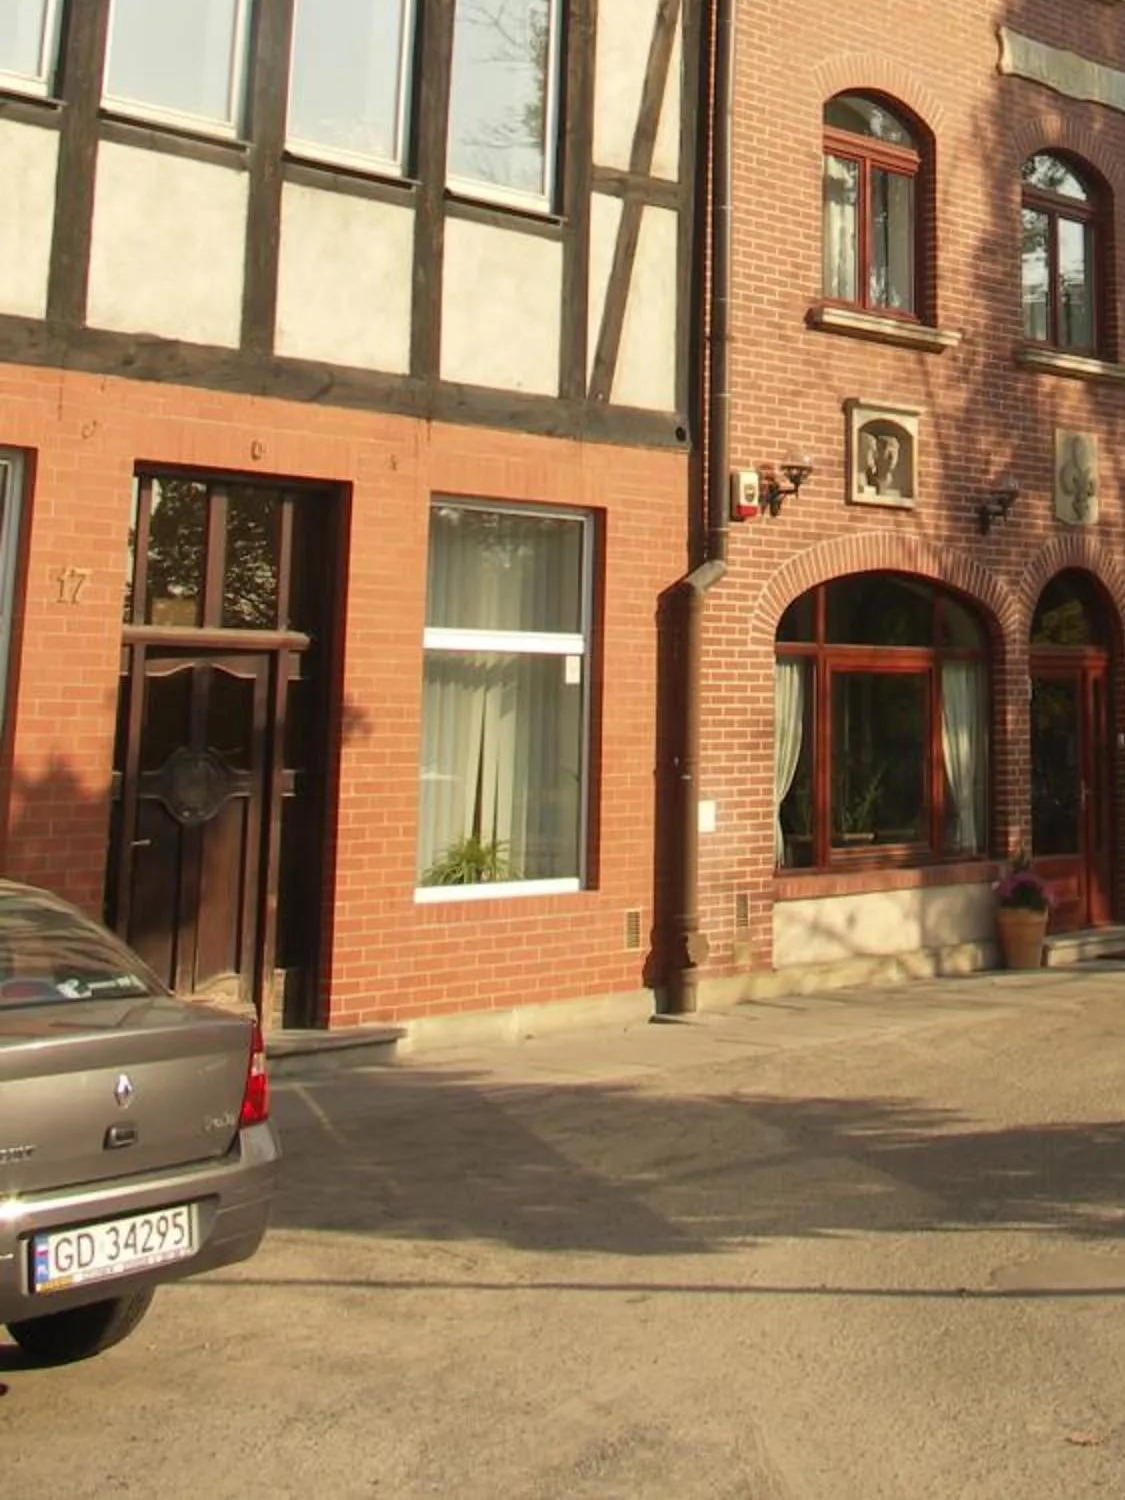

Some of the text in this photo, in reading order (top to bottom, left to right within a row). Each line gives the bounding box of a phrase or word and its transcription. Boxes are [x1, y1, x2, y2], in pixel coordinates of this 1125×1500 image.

[56, 567, 88, 604] 17
[54, 1232, 96, 1273] GD
[105, 1211, 186, 1261] 34295
